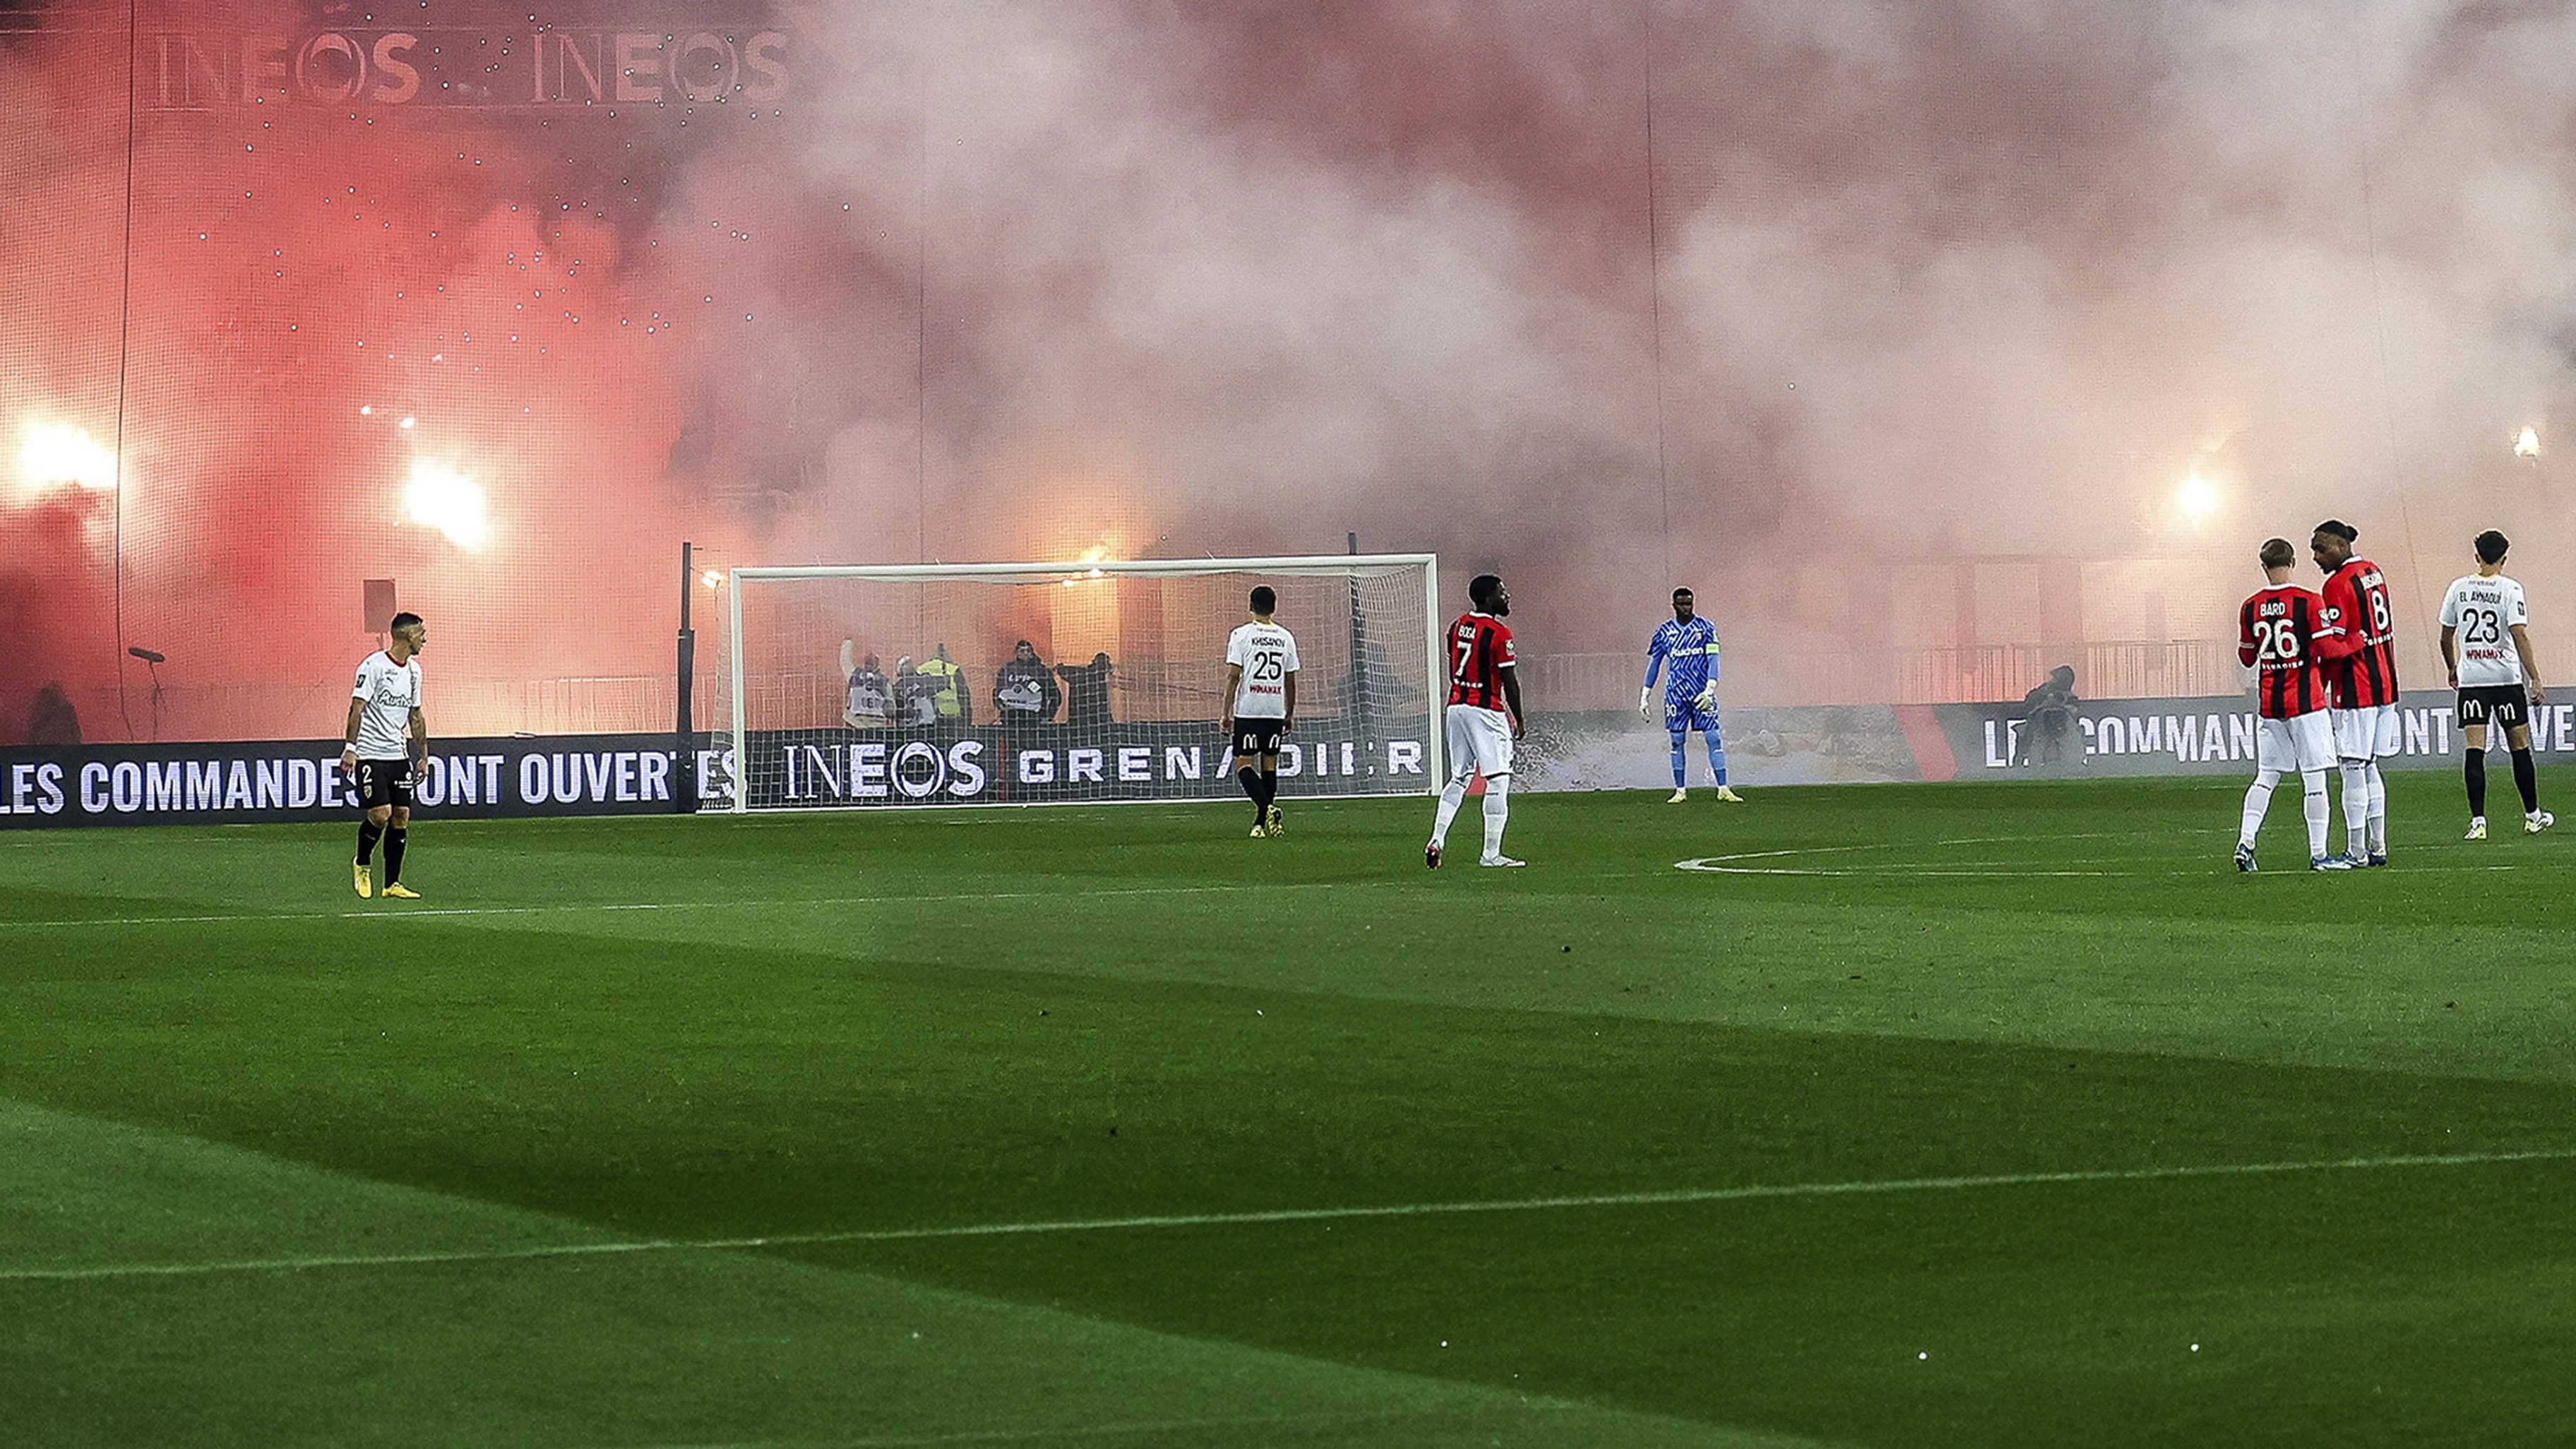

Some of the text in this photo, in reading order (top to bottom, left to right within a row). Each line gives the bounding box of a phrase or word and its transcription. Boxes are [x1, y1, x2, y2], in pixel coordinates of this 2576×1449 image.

[531, 30, 789, 103] INEOS
[2260, 602, 2286, 617] BARD
[2371, 590, 2389, 631] 8
[2462, 608, 2500, 643] 23
[2253, 619, 2301, 660] 26
[1253, 651, 1282, 680] 25
[1457, 640, 1472, 676] 7
[377, 688, 412, 708] Aucha
[362, 764, 373, 784] 2
[410, 755, 504, 806] ONT
[519, 749, 747, 805] OUVERES
[784, 740, 986, 799] INEOS
